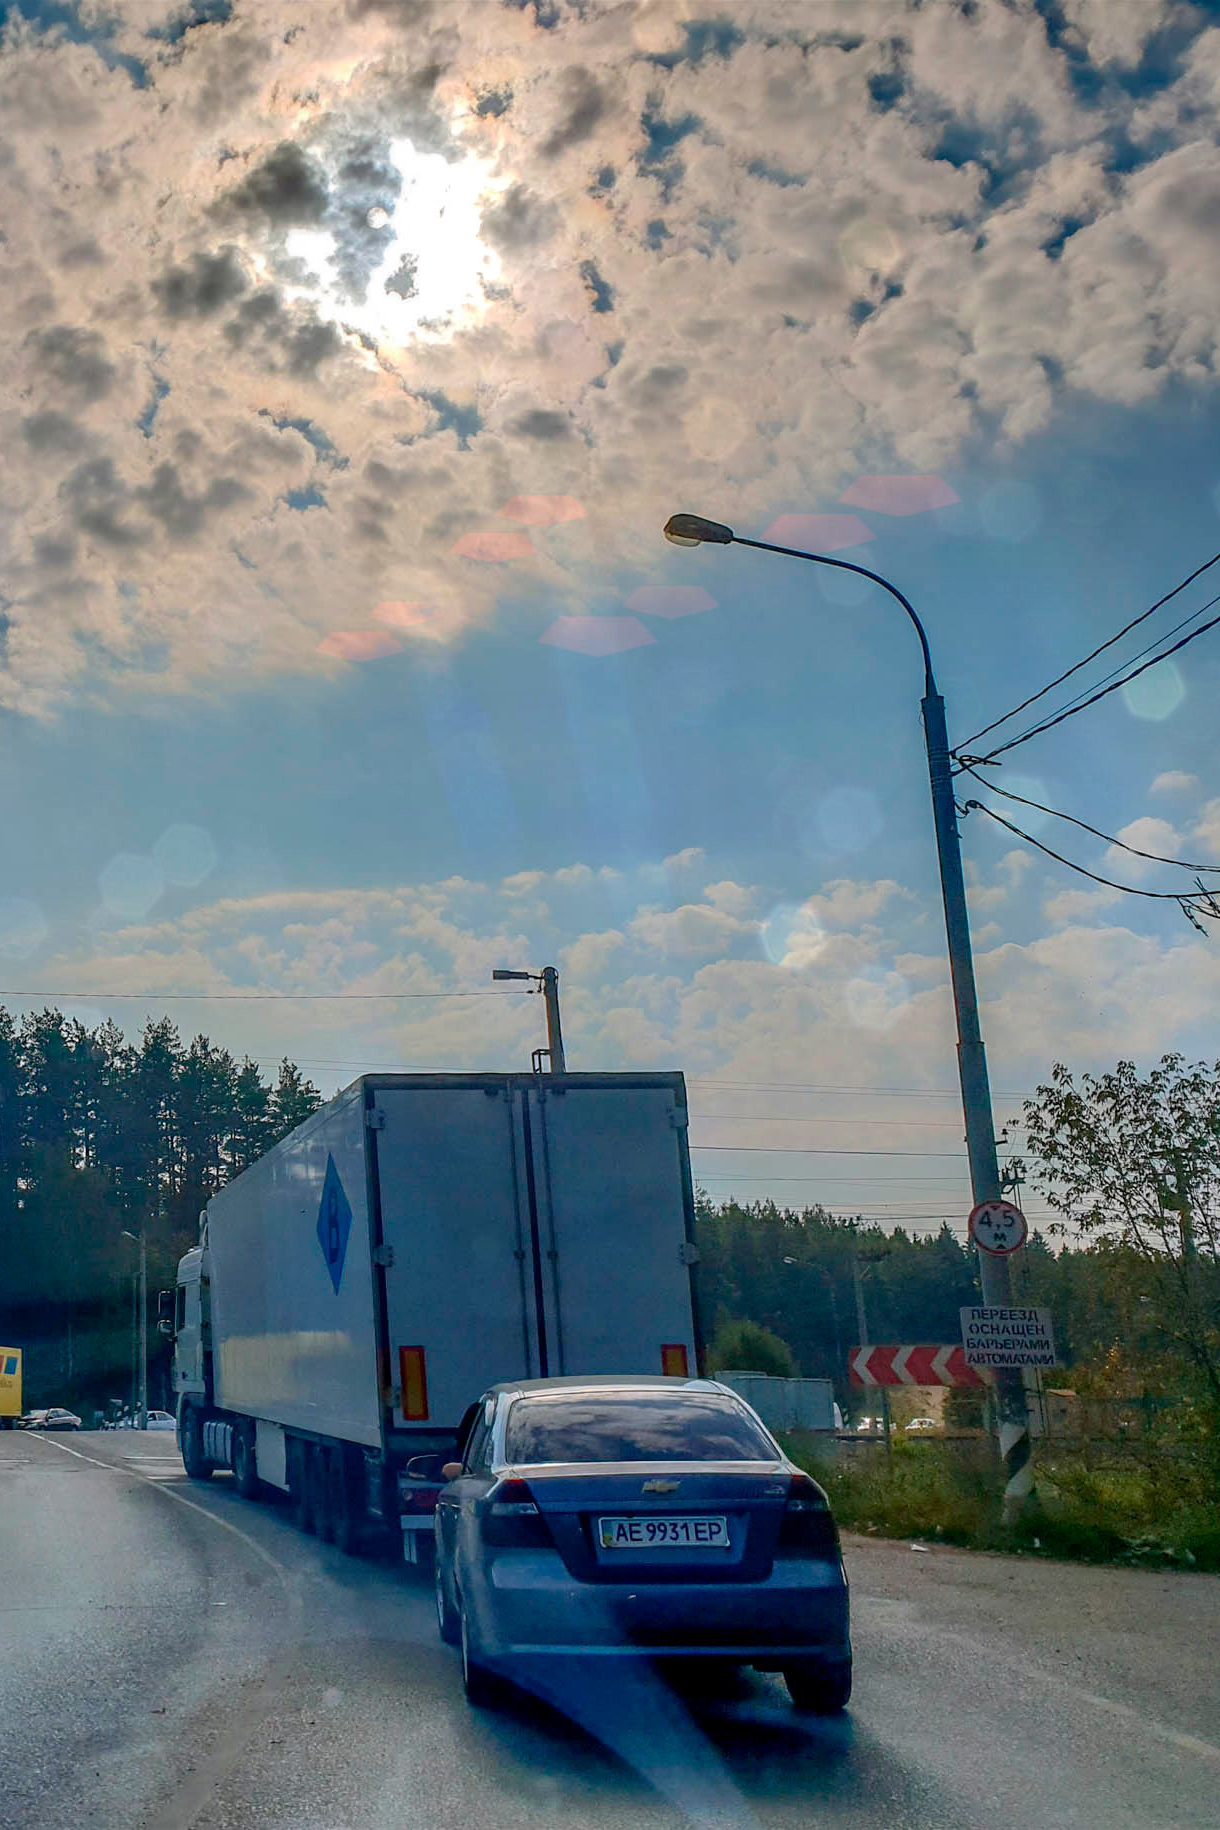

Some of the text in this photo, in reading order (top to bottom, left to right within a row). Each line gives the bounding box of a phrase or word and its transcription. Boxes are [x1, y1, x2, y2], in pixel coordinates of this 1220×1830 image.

[971, 1308, 1039, 1323] ПЕРЕЕЗД
[968, 1323, 1045, 1338] ОСНАЩЕН
[966, 1338, 1050, 1350] БАРЬЕРАМИ
[967, 1352, 1055, 1365] АВТОМАТАМИ
